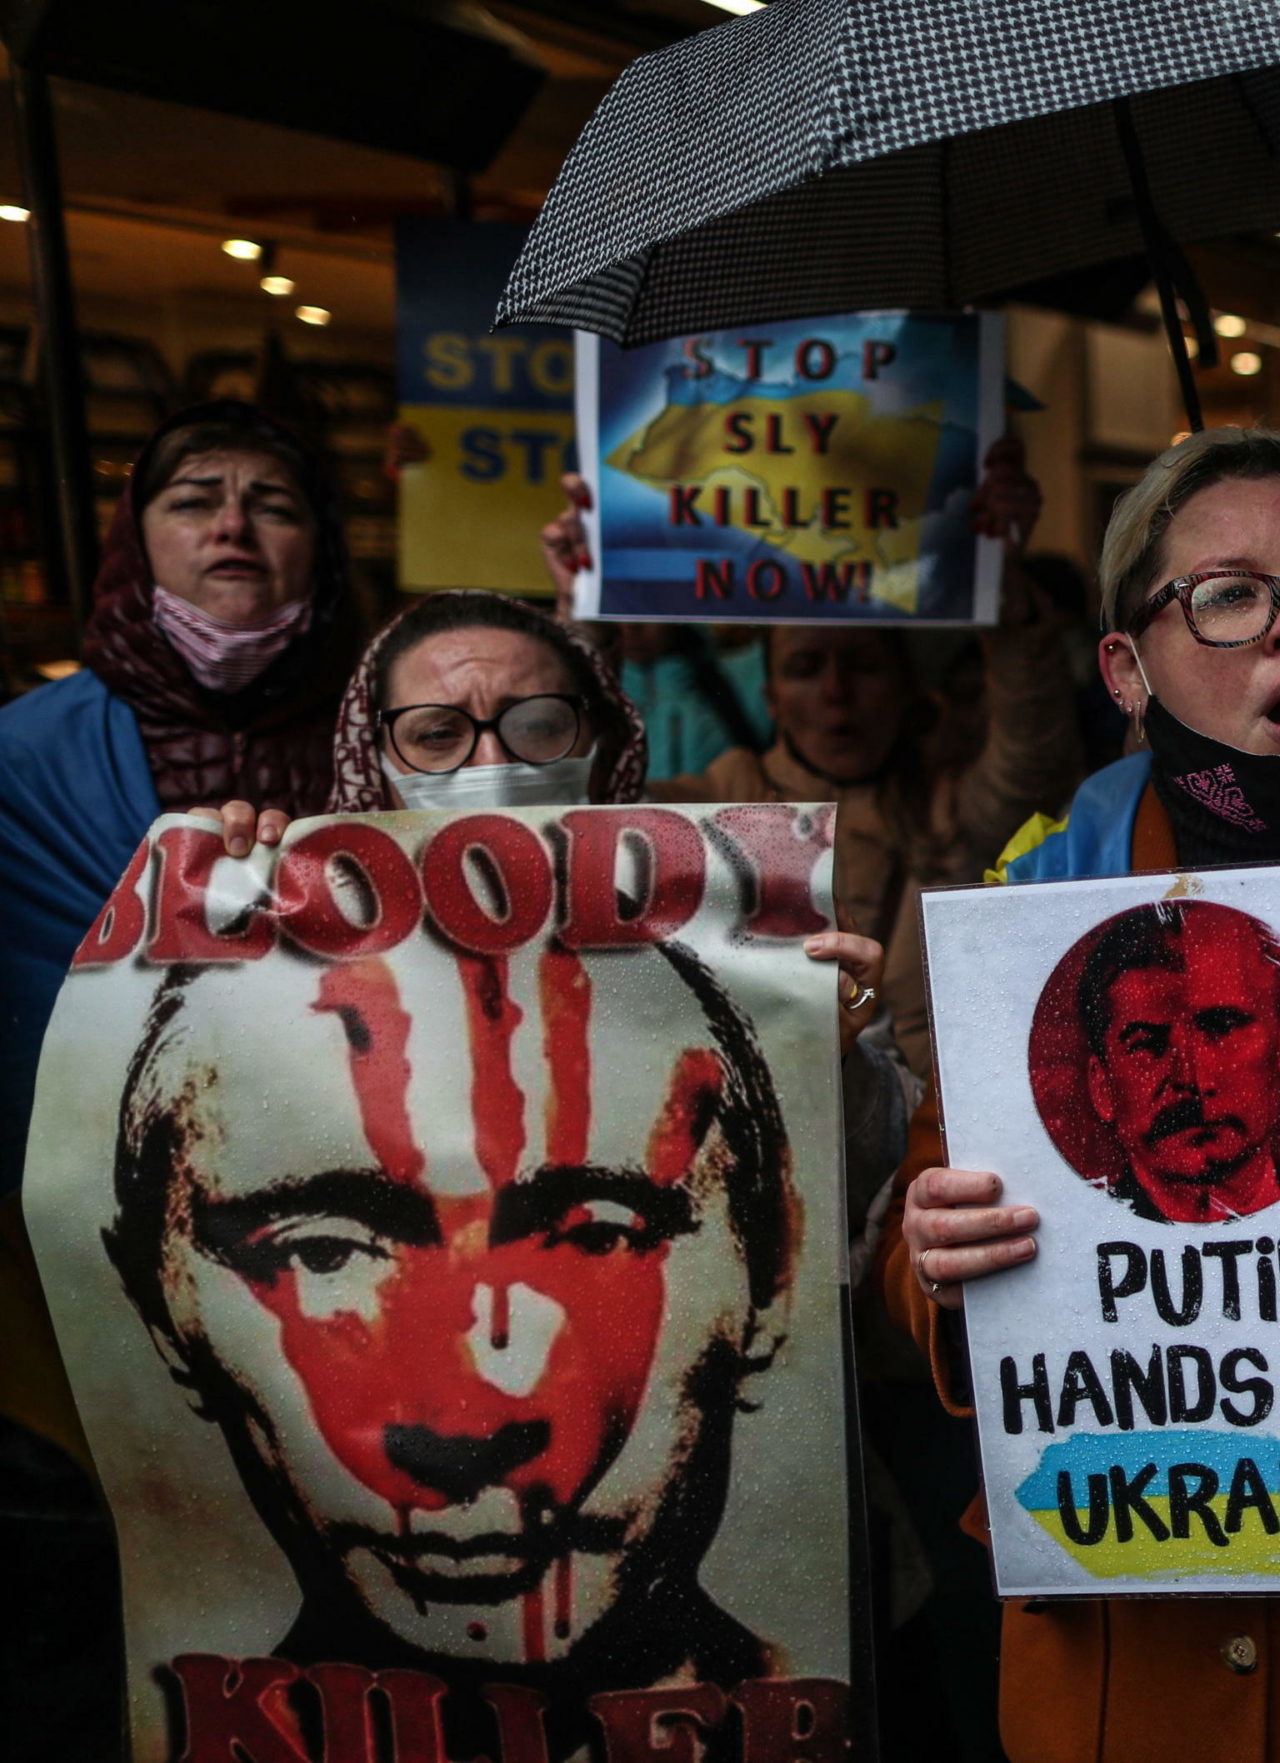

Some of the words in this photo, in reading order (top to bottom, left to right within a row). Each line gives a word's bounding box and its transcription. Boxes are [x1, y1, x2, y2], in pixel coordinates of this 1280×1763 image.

[682, 336, 897, 382] STOP
[460, 427, 579, 484] ST
[726, 410, 839, 455] SLY
[669, 485, 900, 529] KILLER
[694, 558, 874, 605] NOW!
[70, 803, 838, 968] BLOODY
[1000, 1343, 1275, 1435] HANDS
